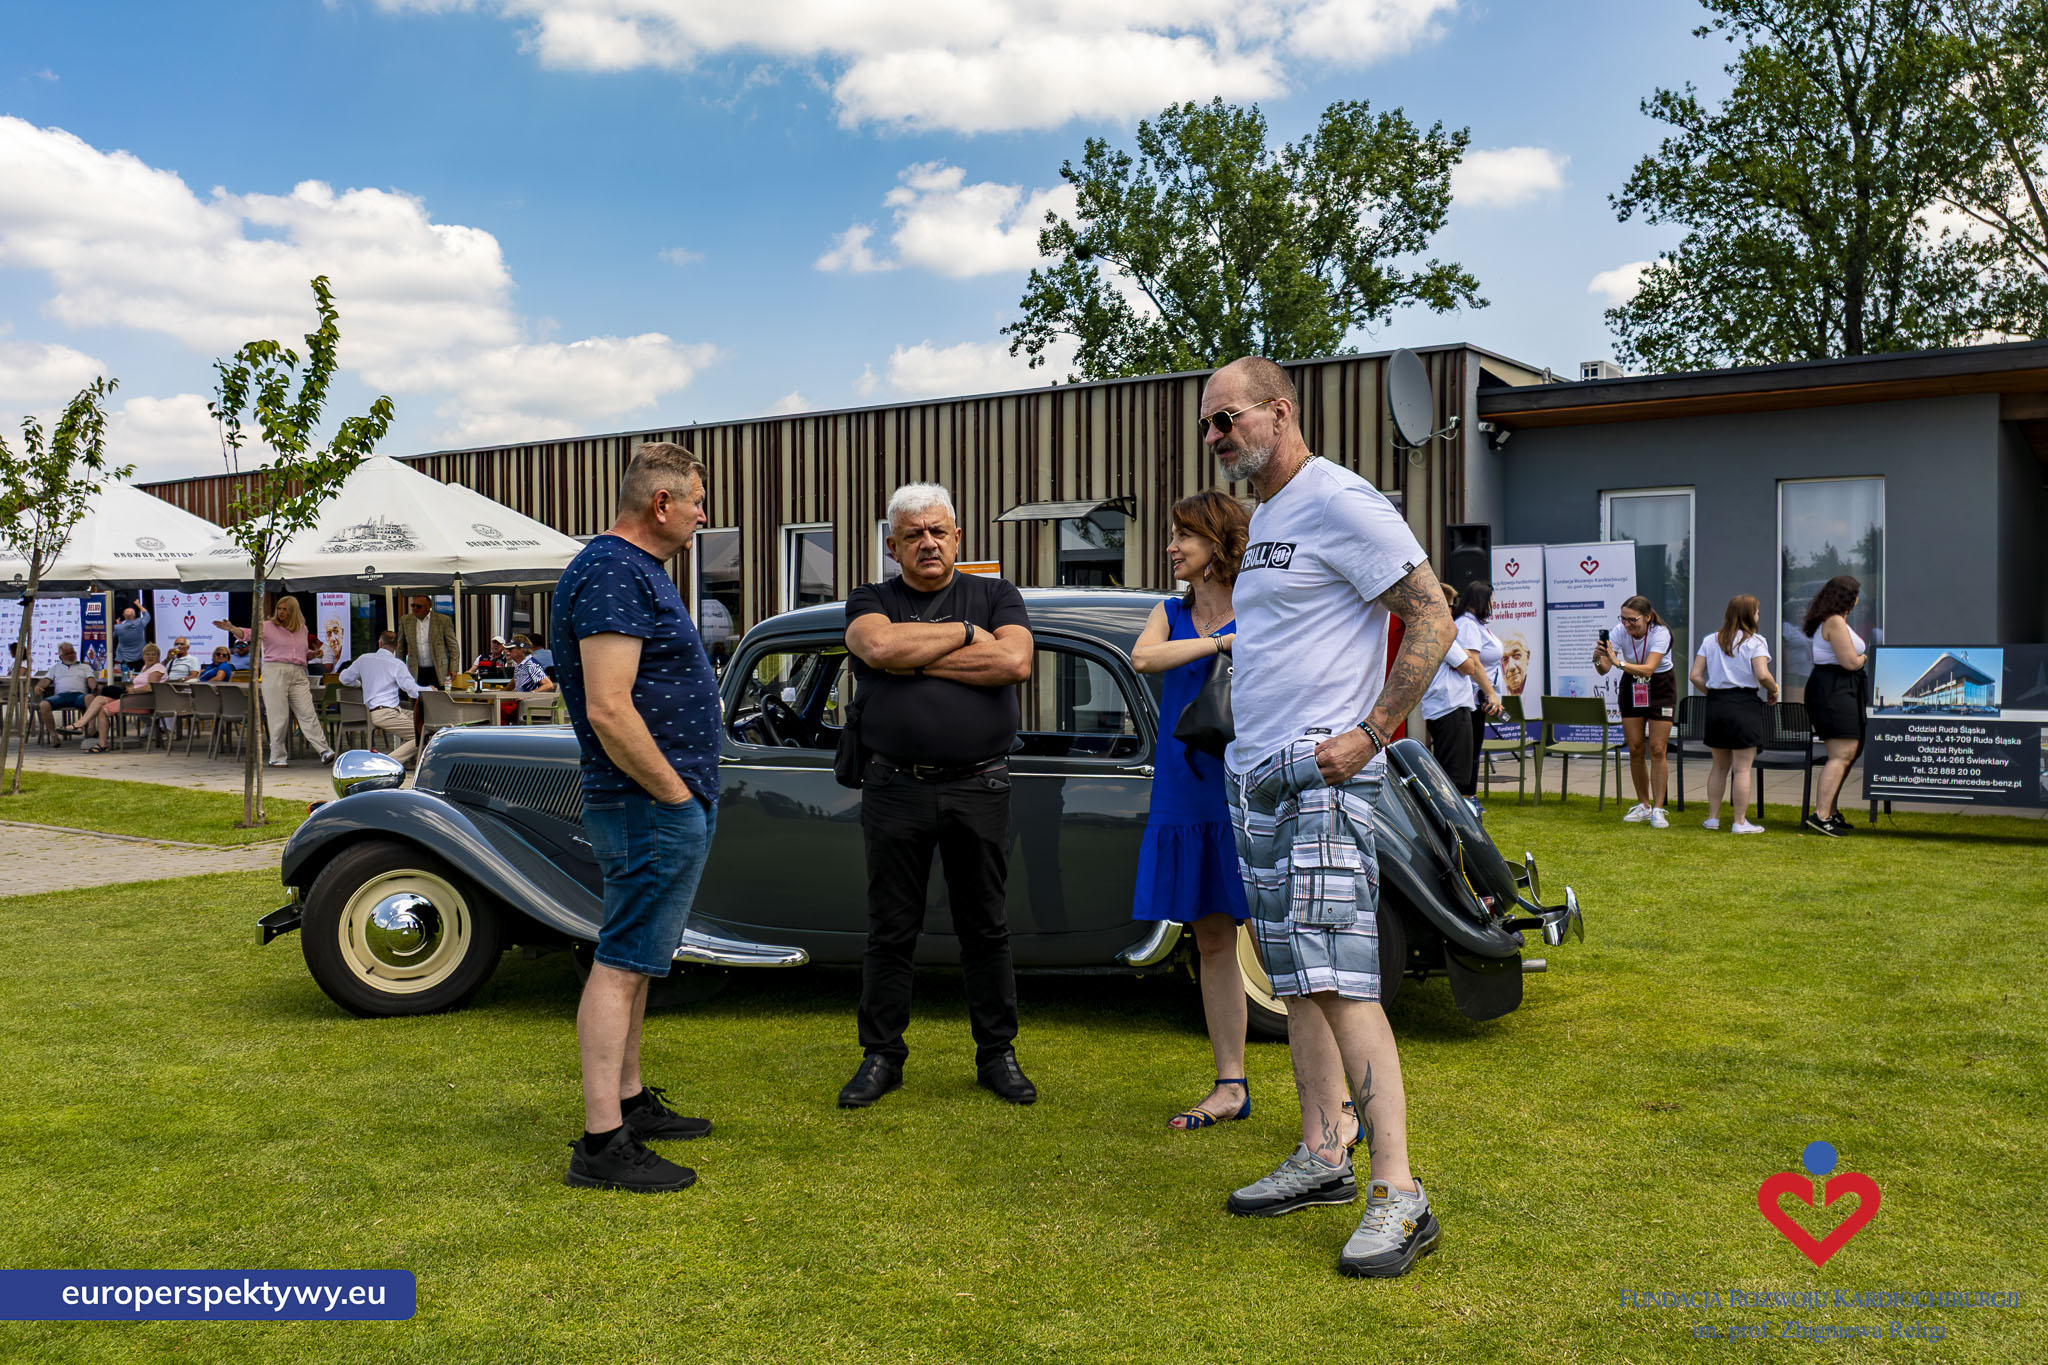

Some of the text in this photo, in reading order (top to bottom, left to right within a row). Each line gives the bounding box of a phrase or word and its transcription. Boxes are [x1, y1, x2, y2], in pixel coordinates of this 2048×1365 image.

[1518, 600, 1533, 608] serce
[1495, 610, 1514, 620] wielka
[1514, 609, 1537, 621] sprawa!
[1908, 725, 1985, 735] Oddział Ruda Śląska
[1884, 734, 1903, 743] Szyb
[1904, 735, 1934, 744] Barbary
[1935, 735, 1943, 743] 3,
[1944, 735, 1971, 744] 41-709
[1972, 736, 1993, 744] Ruda
[1994, 735, 2022, 746] Śląska
[1917, 746, 1974, 755] Oddział Rybnik
[1894, 754, 1920, 763] Żorska
[1921, 756, 1935, 764] 39,
[1936, 756, 1965, 764] 44-266
[1966, 756, 2009, 767] Świerklany
[1912, 766, 1981, 776] Tel. 32 888 20 00
[1873, 774, 2022, 789] E-mail: info@intercar.mercedes-benz.pl
